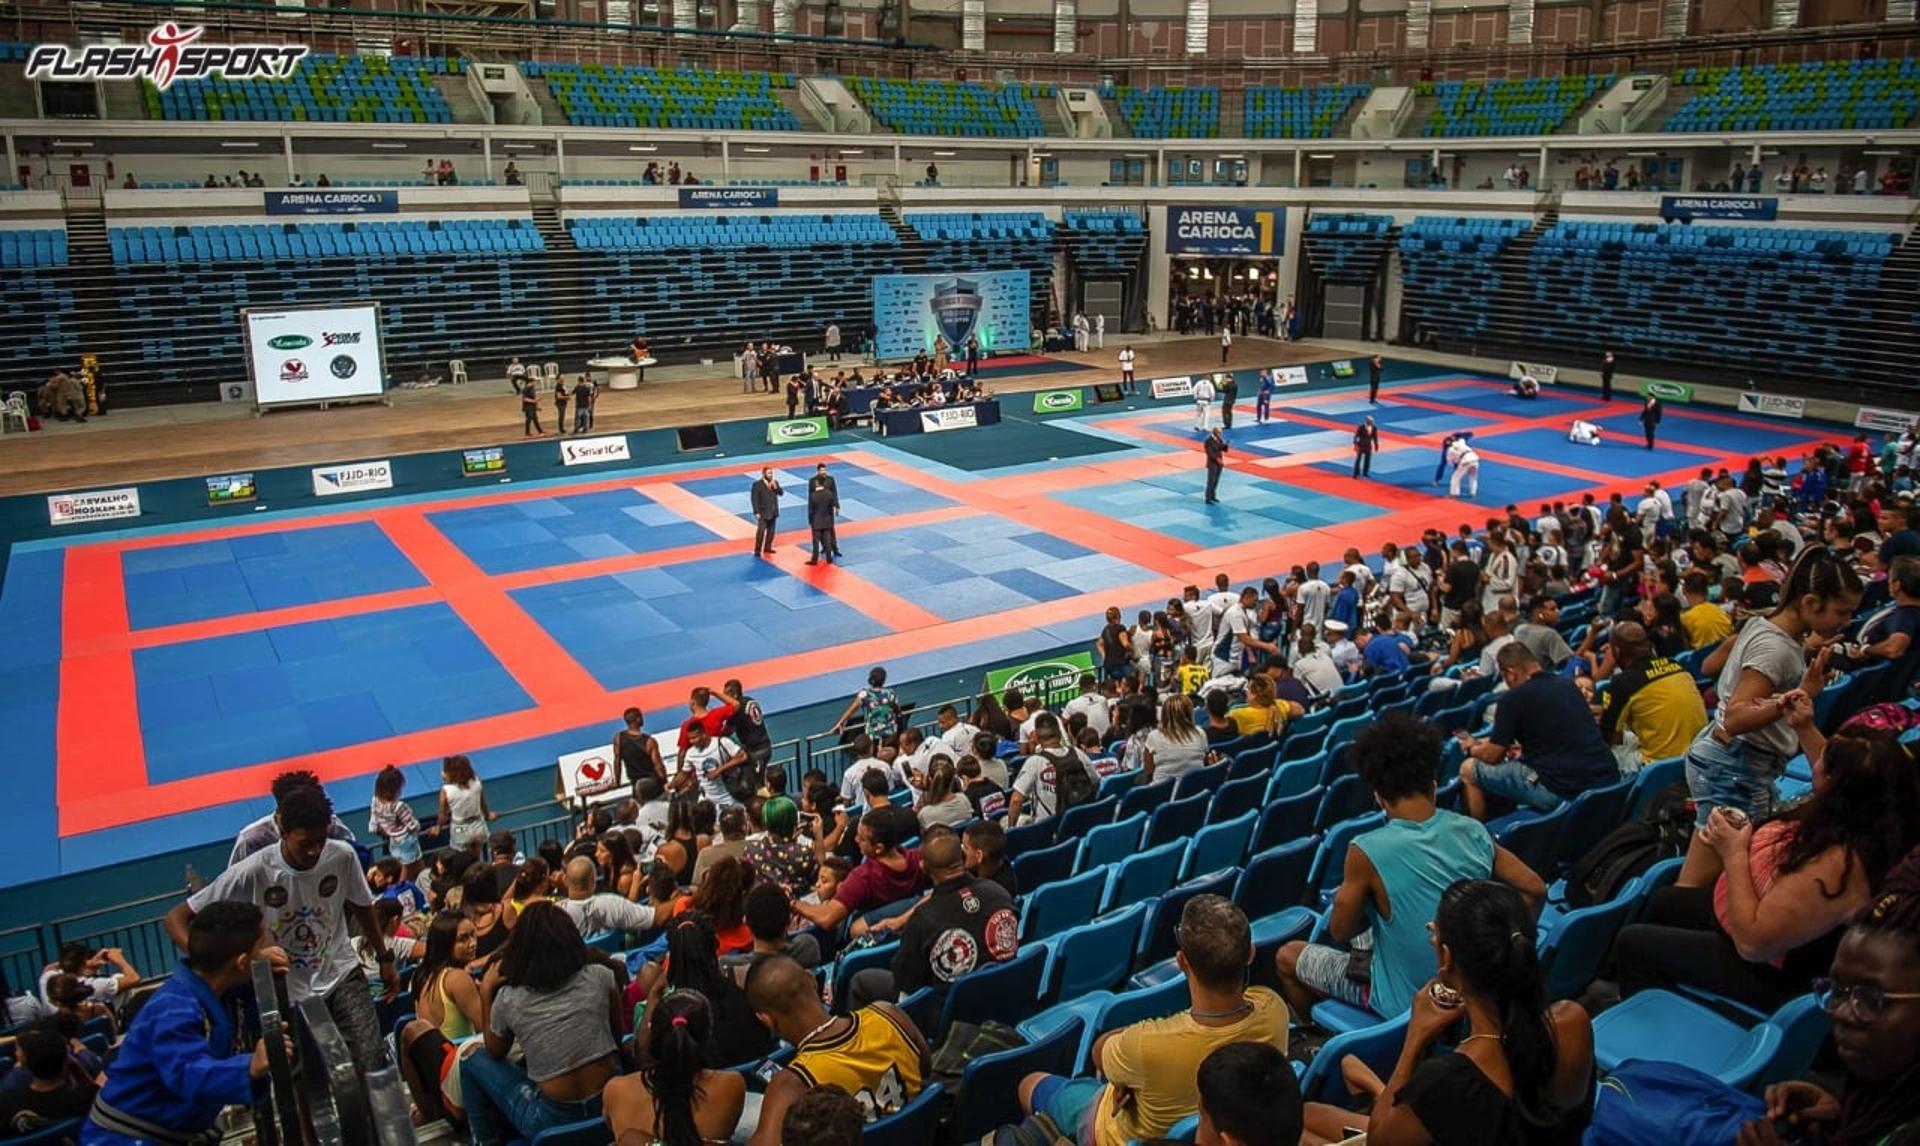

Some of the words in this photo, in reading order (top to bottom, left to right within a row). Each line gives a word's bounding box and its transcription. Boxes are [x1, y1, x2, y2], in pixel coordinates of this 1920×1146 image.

[281, 193, 323, 204] ARENA
[324, 193, 376, 204] CARIOCA
[691, 191, 722, 199] ARENA
[723, 191, 762, 199] CARIOCA
[1674, 199, 1709, 208] ARENA
[1709, 200, 1757, 209] CARIOCA
[1178, 211, 1240, 224] ARENA
[1178, 226, 1256, 239] CARIOCA
[1255, 211, 1274, 253] 1
[74, 494, 128, 506] CARVALHO
